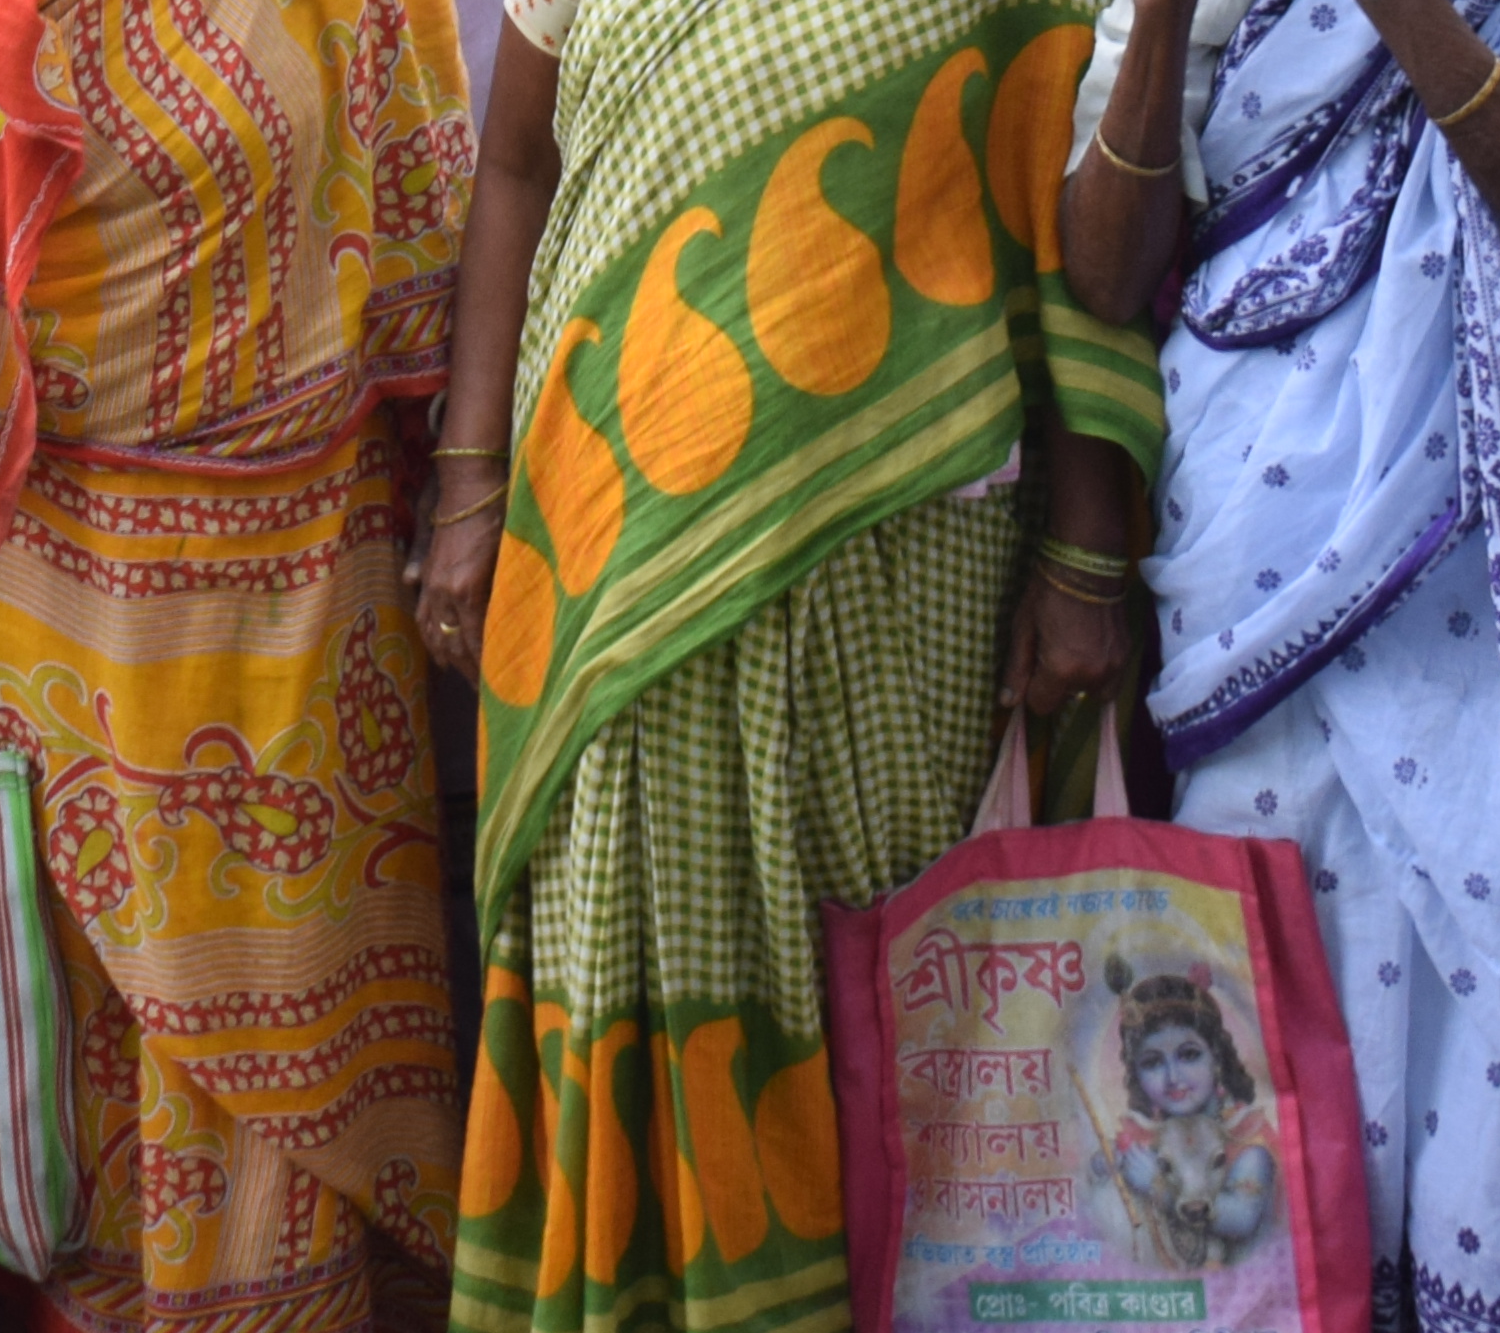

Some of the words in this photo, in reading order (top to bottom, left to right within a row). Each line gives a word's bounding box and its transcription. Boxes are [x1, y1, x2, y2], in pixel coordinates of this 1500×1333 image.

[895, 927, 1085, 1034] শ্রীকৃষ্ণ
[900, 1047, 1051, 1101] বস্ত্রালয়
[934, 1177, 1073, 1220] বাসনালয়
